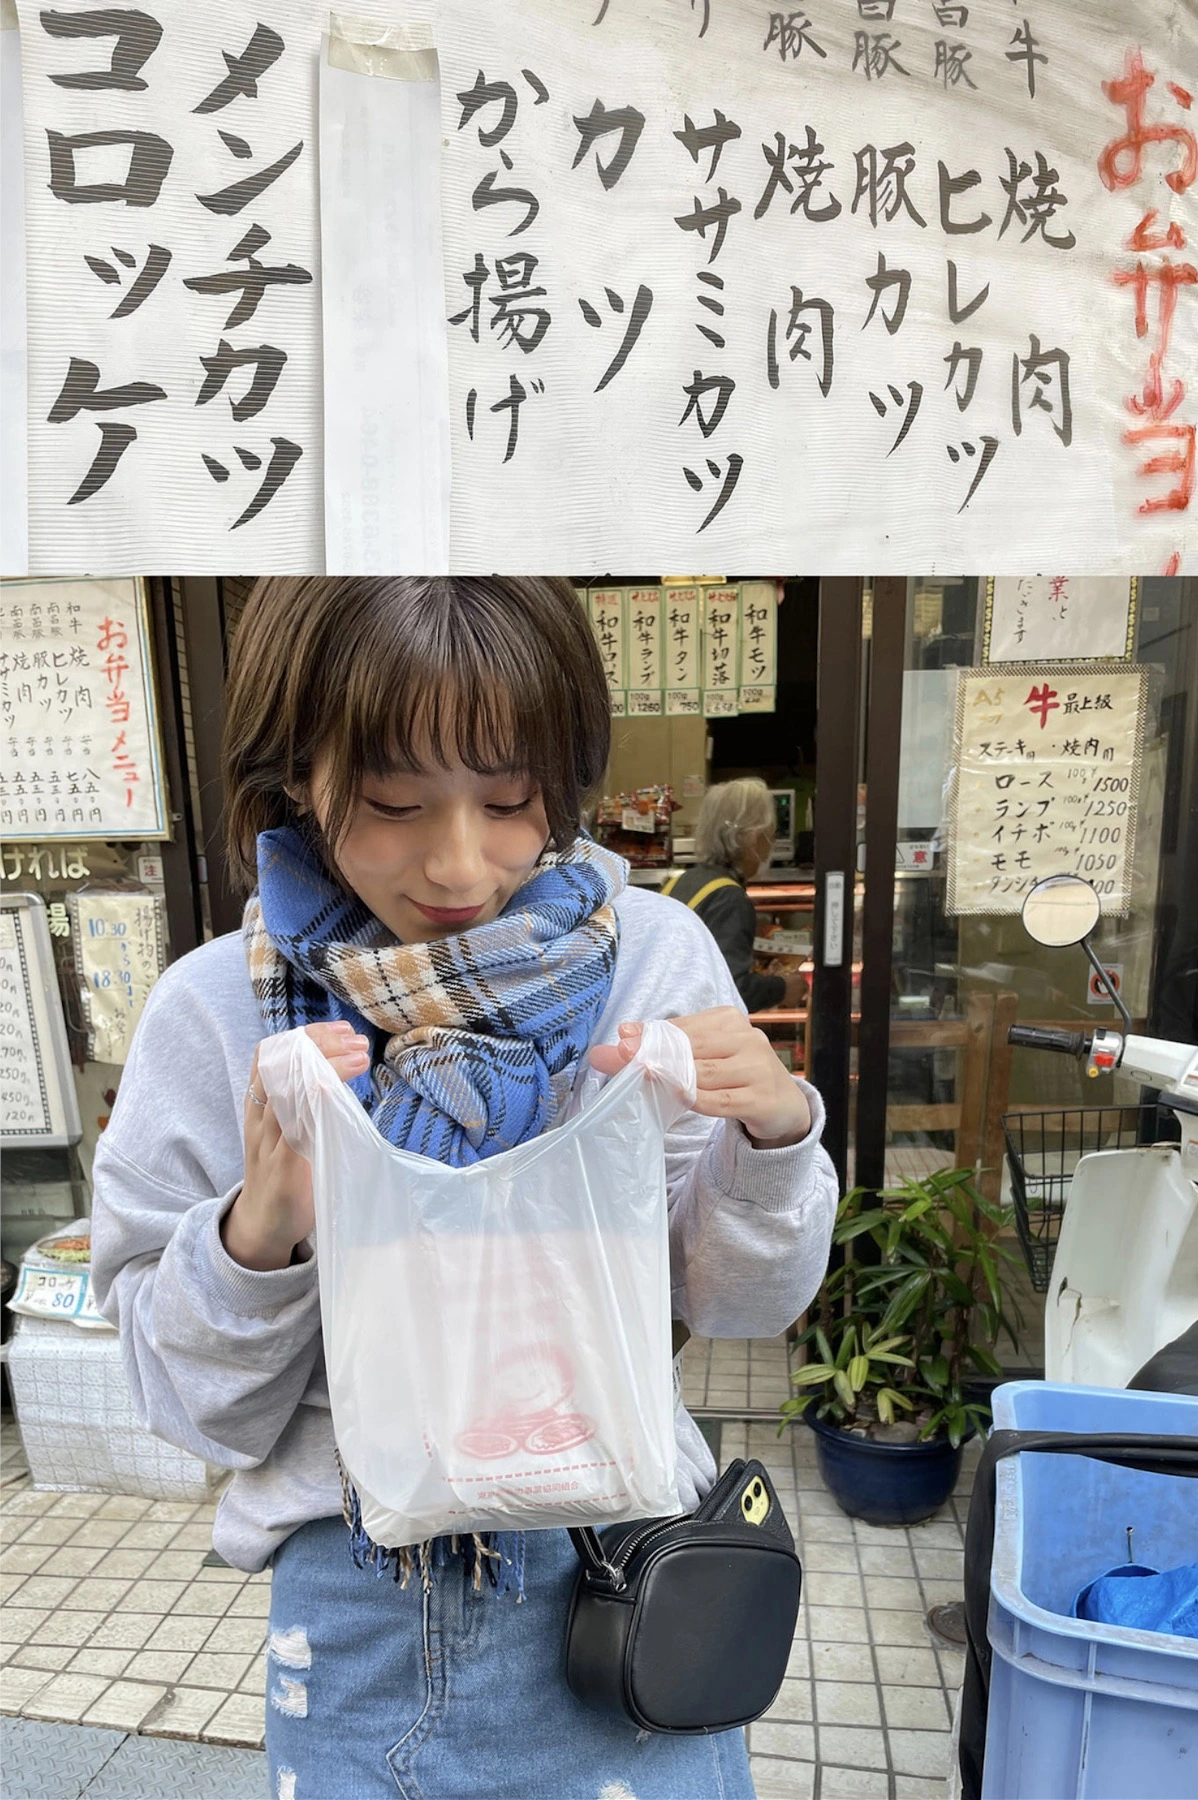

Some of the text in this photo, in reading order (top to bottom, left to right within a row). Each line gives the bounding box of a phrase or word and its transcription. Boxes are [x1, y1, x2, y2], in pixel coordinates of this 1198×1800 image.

[39, 8, 175, 505] コロッケ
[182, 22, 313, 531] メンチカツ
[447, 69, 551, 464] から揚げ
[571, 100, 653, 393] カツ
[673, 109, 744, 534] ササミカツ
[754, 125, 842, 398] 焼肉
[850, 142, 927, 457] 豚カツ
[938, 159, 999, 514] ヒレカツ
[997, 147, 1077, 447] 焼肉
[1097, 45, 1198, 576] お弁当
[96, 616, 140, 807] お弁当メニュー
[668, 608, 690, 681] 和牛タン
[744, 604, 767, 681] 和牛モツ
[1023, 683, 1060, 730] 牛
[1062, 693, 1113, 715] 最上級
[991, 850, 1031, 871] モモ
[992, 821, 1055, 843] イチボ
[993, 796, 1055, 821] ランプ
[995, 771, 1054, 789] ロース
